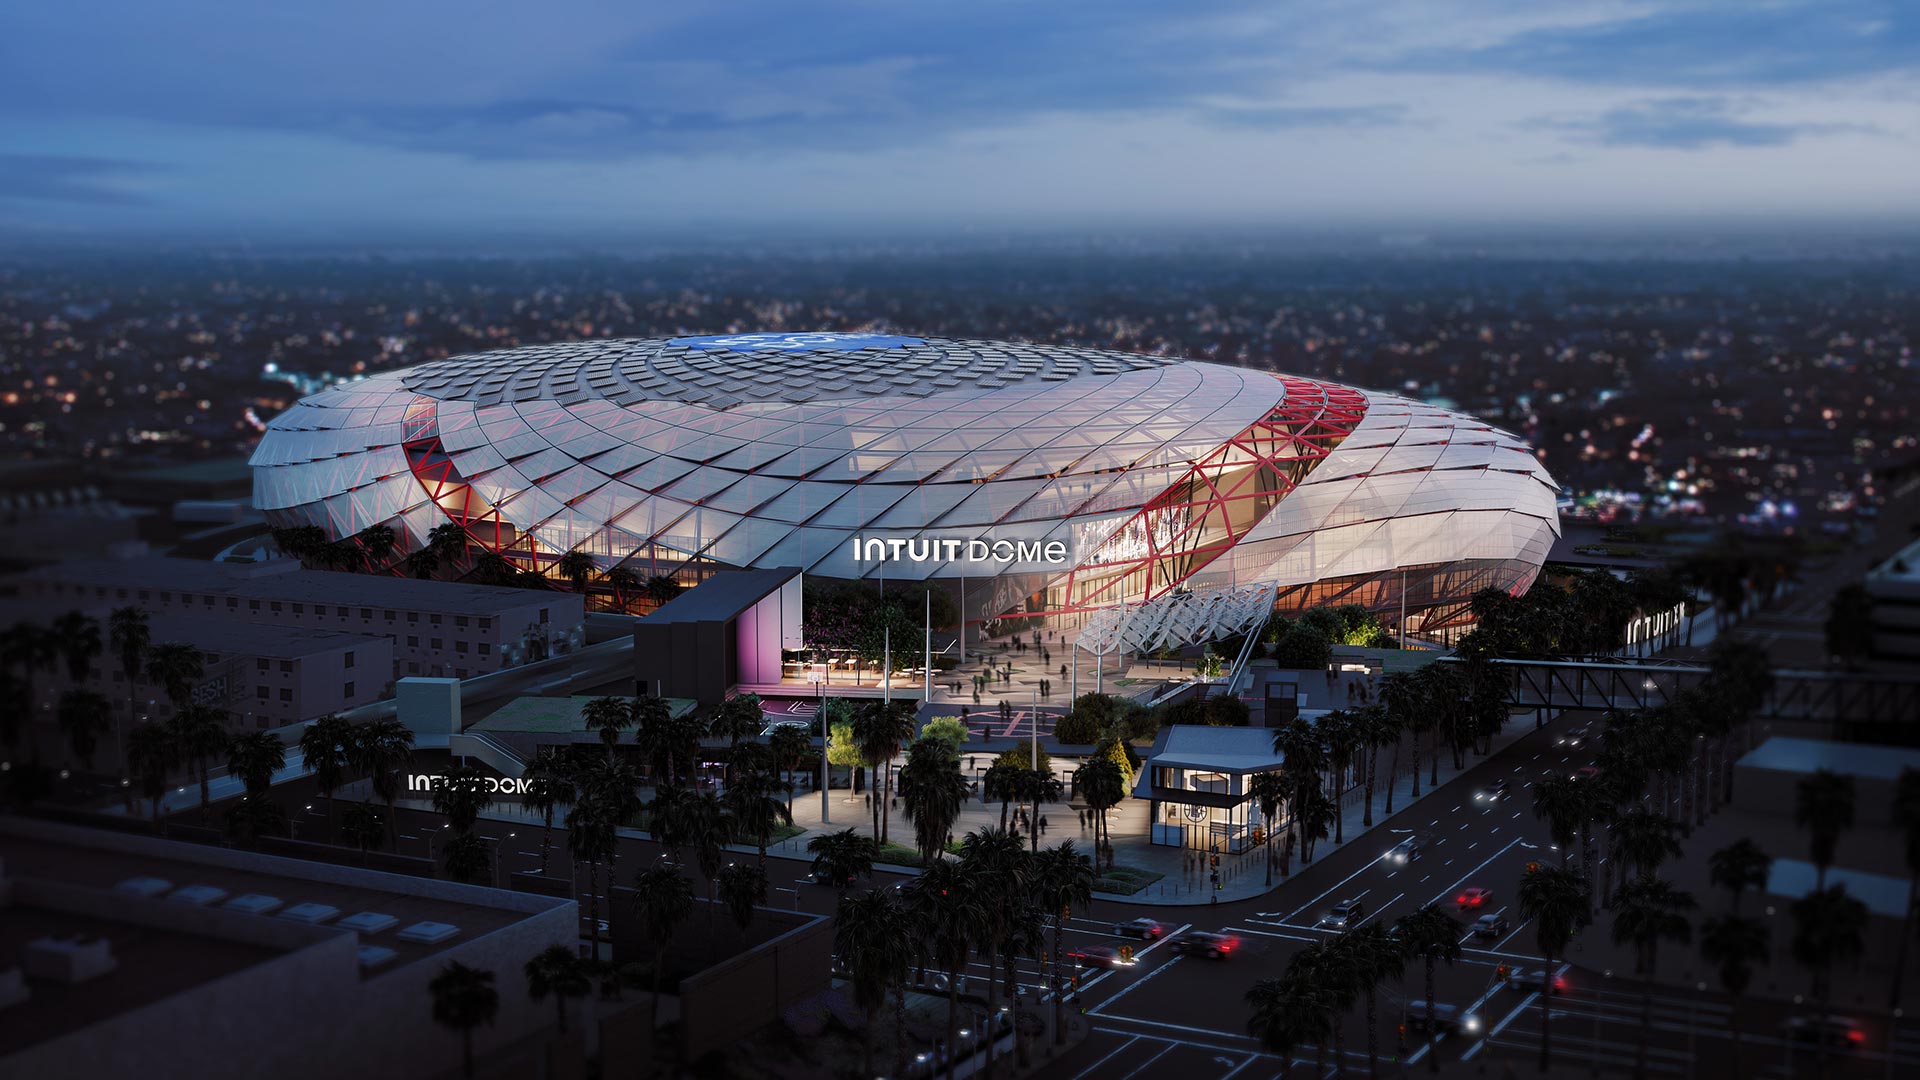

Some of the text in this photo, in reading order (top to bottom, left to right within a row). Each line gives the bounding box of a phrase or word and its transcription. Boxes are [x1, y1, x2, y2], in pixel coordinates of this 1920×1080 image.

[854, 538, 1067, 563] INTUIT DOME
[484, 776, 548, 796] DOM
